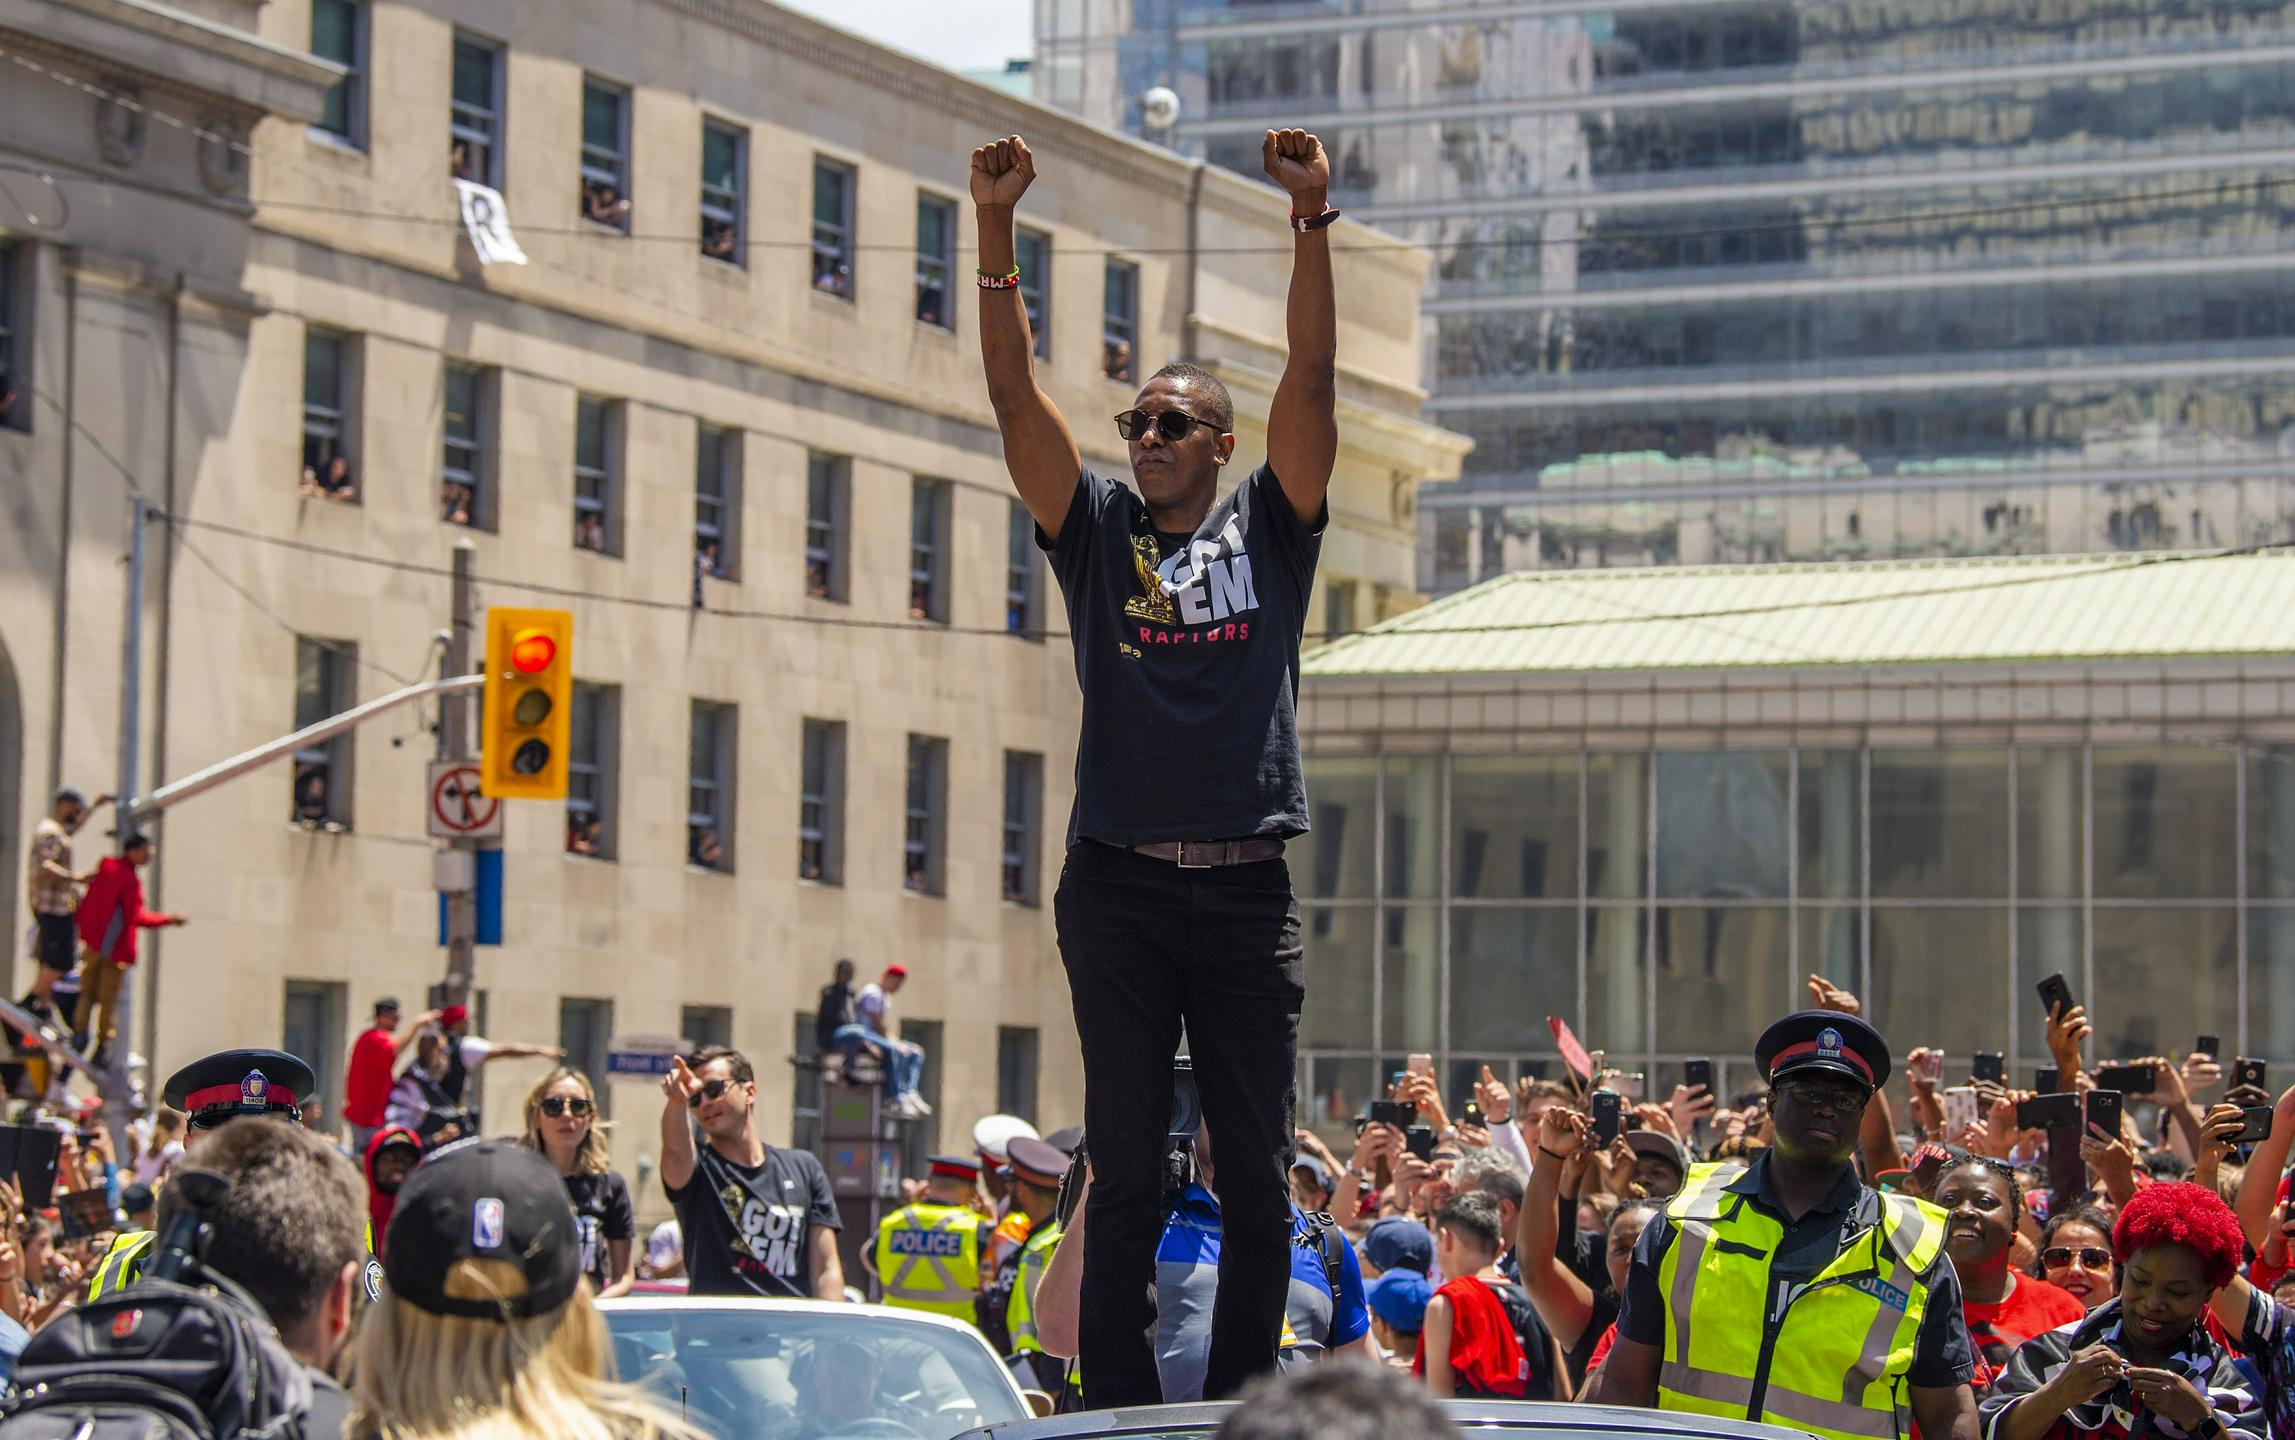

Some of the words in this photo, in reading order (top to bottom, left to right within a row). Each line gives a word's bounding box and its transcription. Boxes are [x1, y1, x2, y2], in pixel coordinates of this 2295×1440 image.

[469, 190, 503, 260] R
[742, 1199, 805, 1242] GOT
[892, 1230, 959, 1254] POLICE
[1848, 1277, 1906, 1308] OLICE
